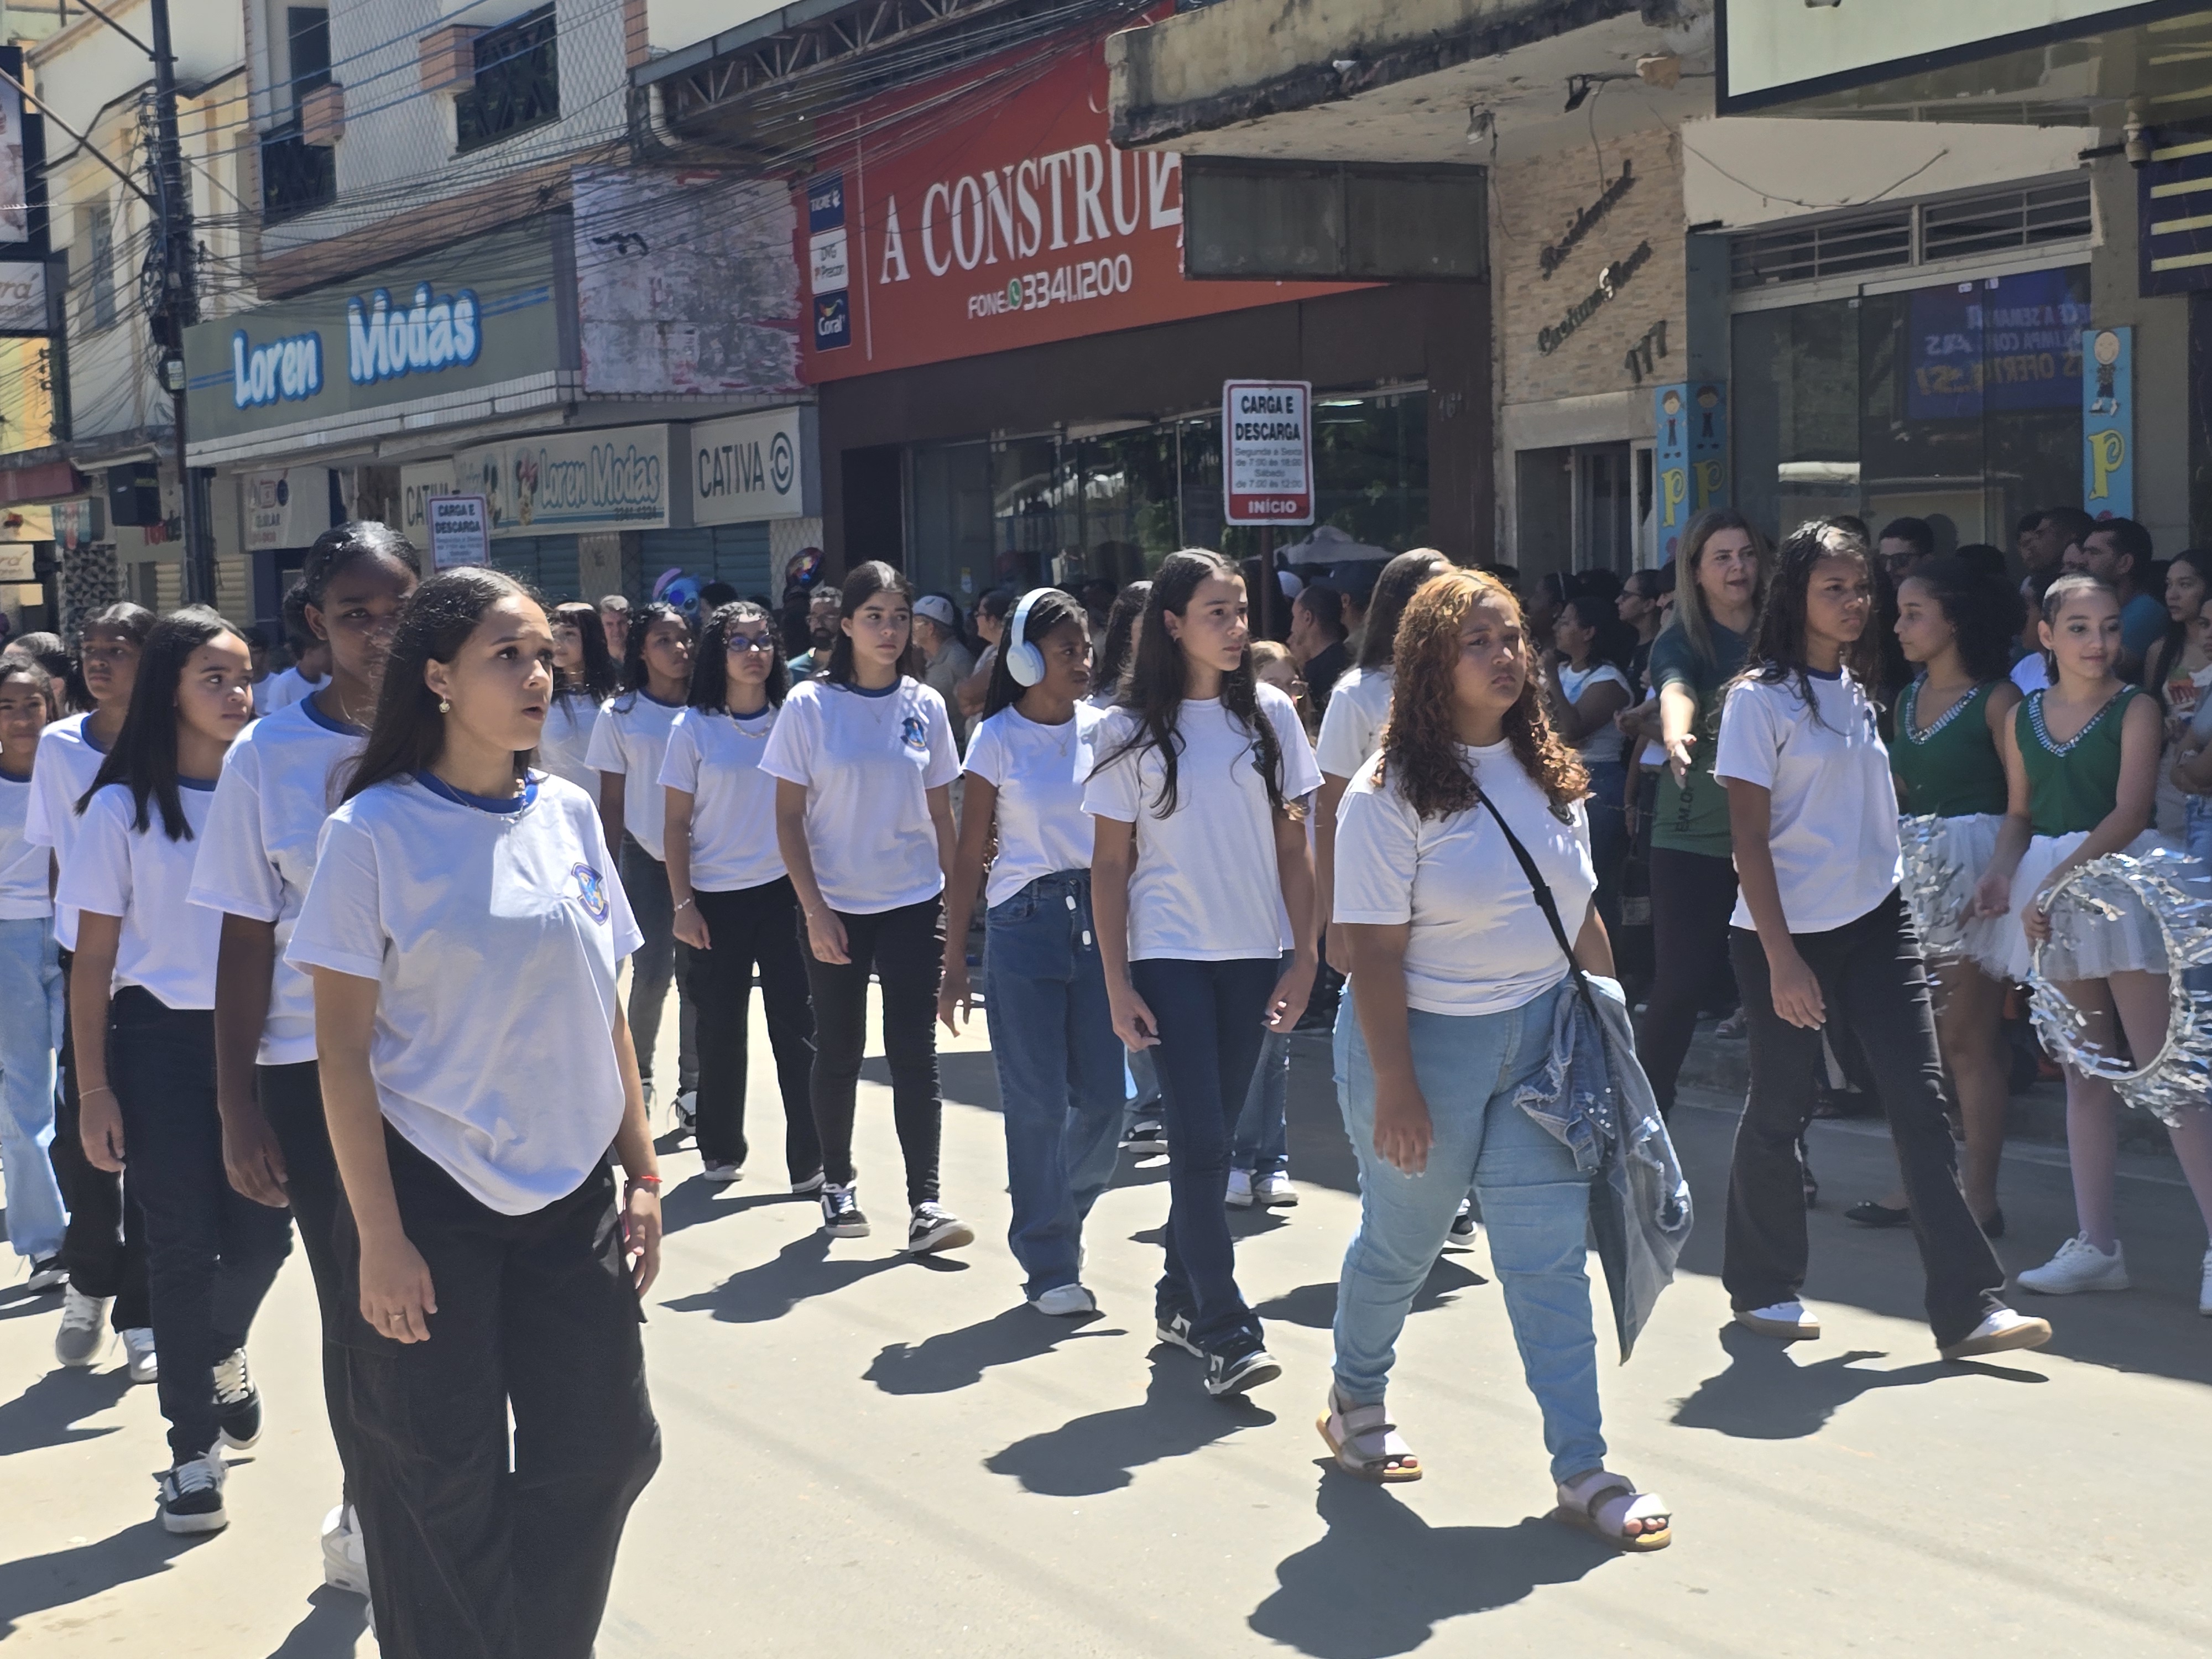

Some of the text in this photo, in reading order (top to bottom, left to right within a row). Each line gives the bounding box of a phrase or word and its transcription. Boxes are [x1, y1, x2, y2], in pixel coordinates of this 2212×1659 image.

[879, 194, 910, 284] A
[818, 315, 843, 336] Coral
[233, 281, 482, 409] Loren Modas
[1625, 320, 1667, 383] 177
[1241, 395, 1293, 414] CARGA E
[1235, 422, 1301, 441] DESCARGA
[539, 448, 588, 509] Loren
[591, 442, 660, 507] Modas
[698, 441, 765, 499] CATIVA
[437, 504, 476, 517] CARGA E
[1248, 498, 1297, 514] INÍCIO
[435, 520, 481, 534] DESCARGA
